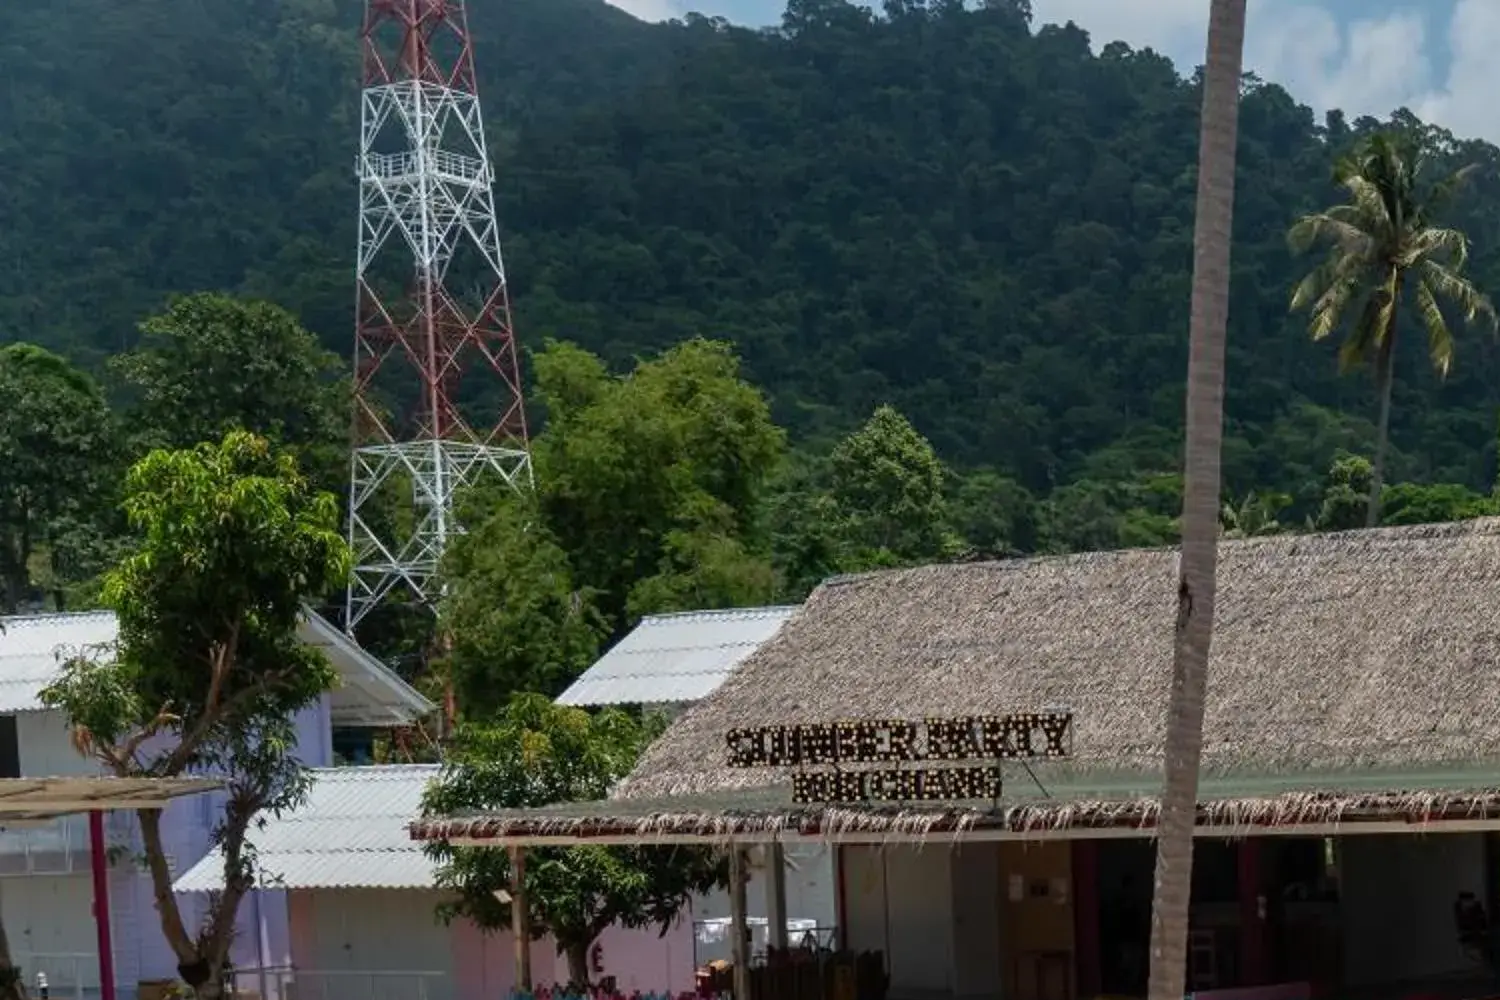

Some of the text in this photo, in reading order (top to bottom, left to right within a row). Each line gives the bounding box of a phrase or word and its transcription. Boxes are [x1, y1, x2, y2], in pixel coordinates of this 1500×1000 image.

[727, 714, 1073, 768] SLUMBER PARTY
[792, 767, 1002, 802] KOH CHANG
